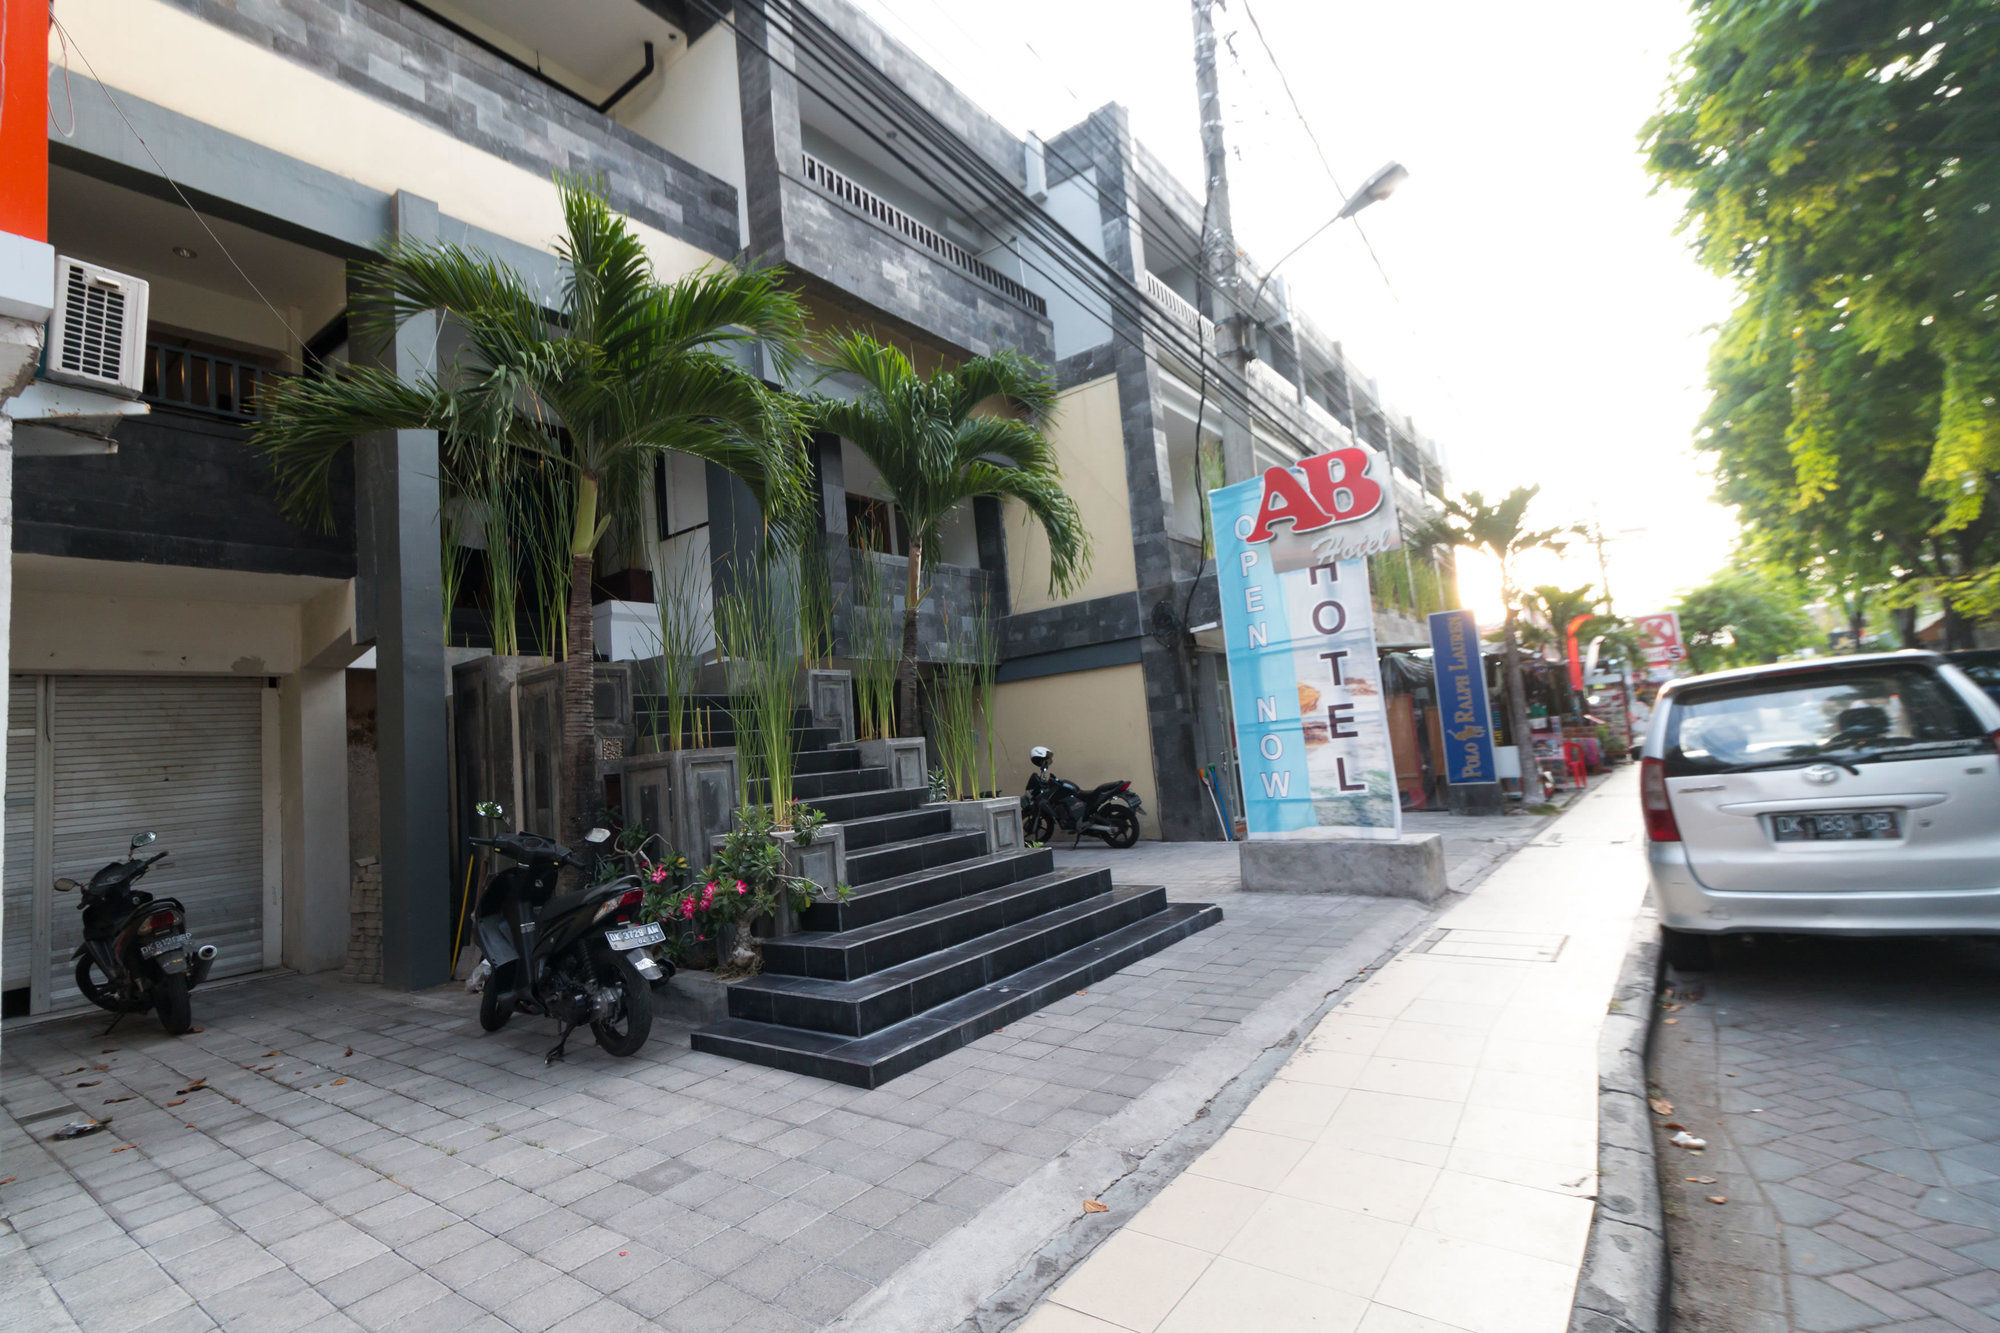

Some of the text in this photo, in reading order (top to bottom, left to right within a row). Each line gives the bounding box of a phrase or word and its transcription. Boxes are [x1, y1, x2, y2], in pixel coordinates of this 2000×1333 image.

[1245, 446, 1384, 544] AB
[1310, 529, 1393, 566] Hotel
[1233, 513, 1291, 798] OPEN NOW
[1447, 615, 1483, 778] POLO RALPH LAUREN
[1776, 816, 1804, 833] DK
[609, 932, 621, 941] DK
